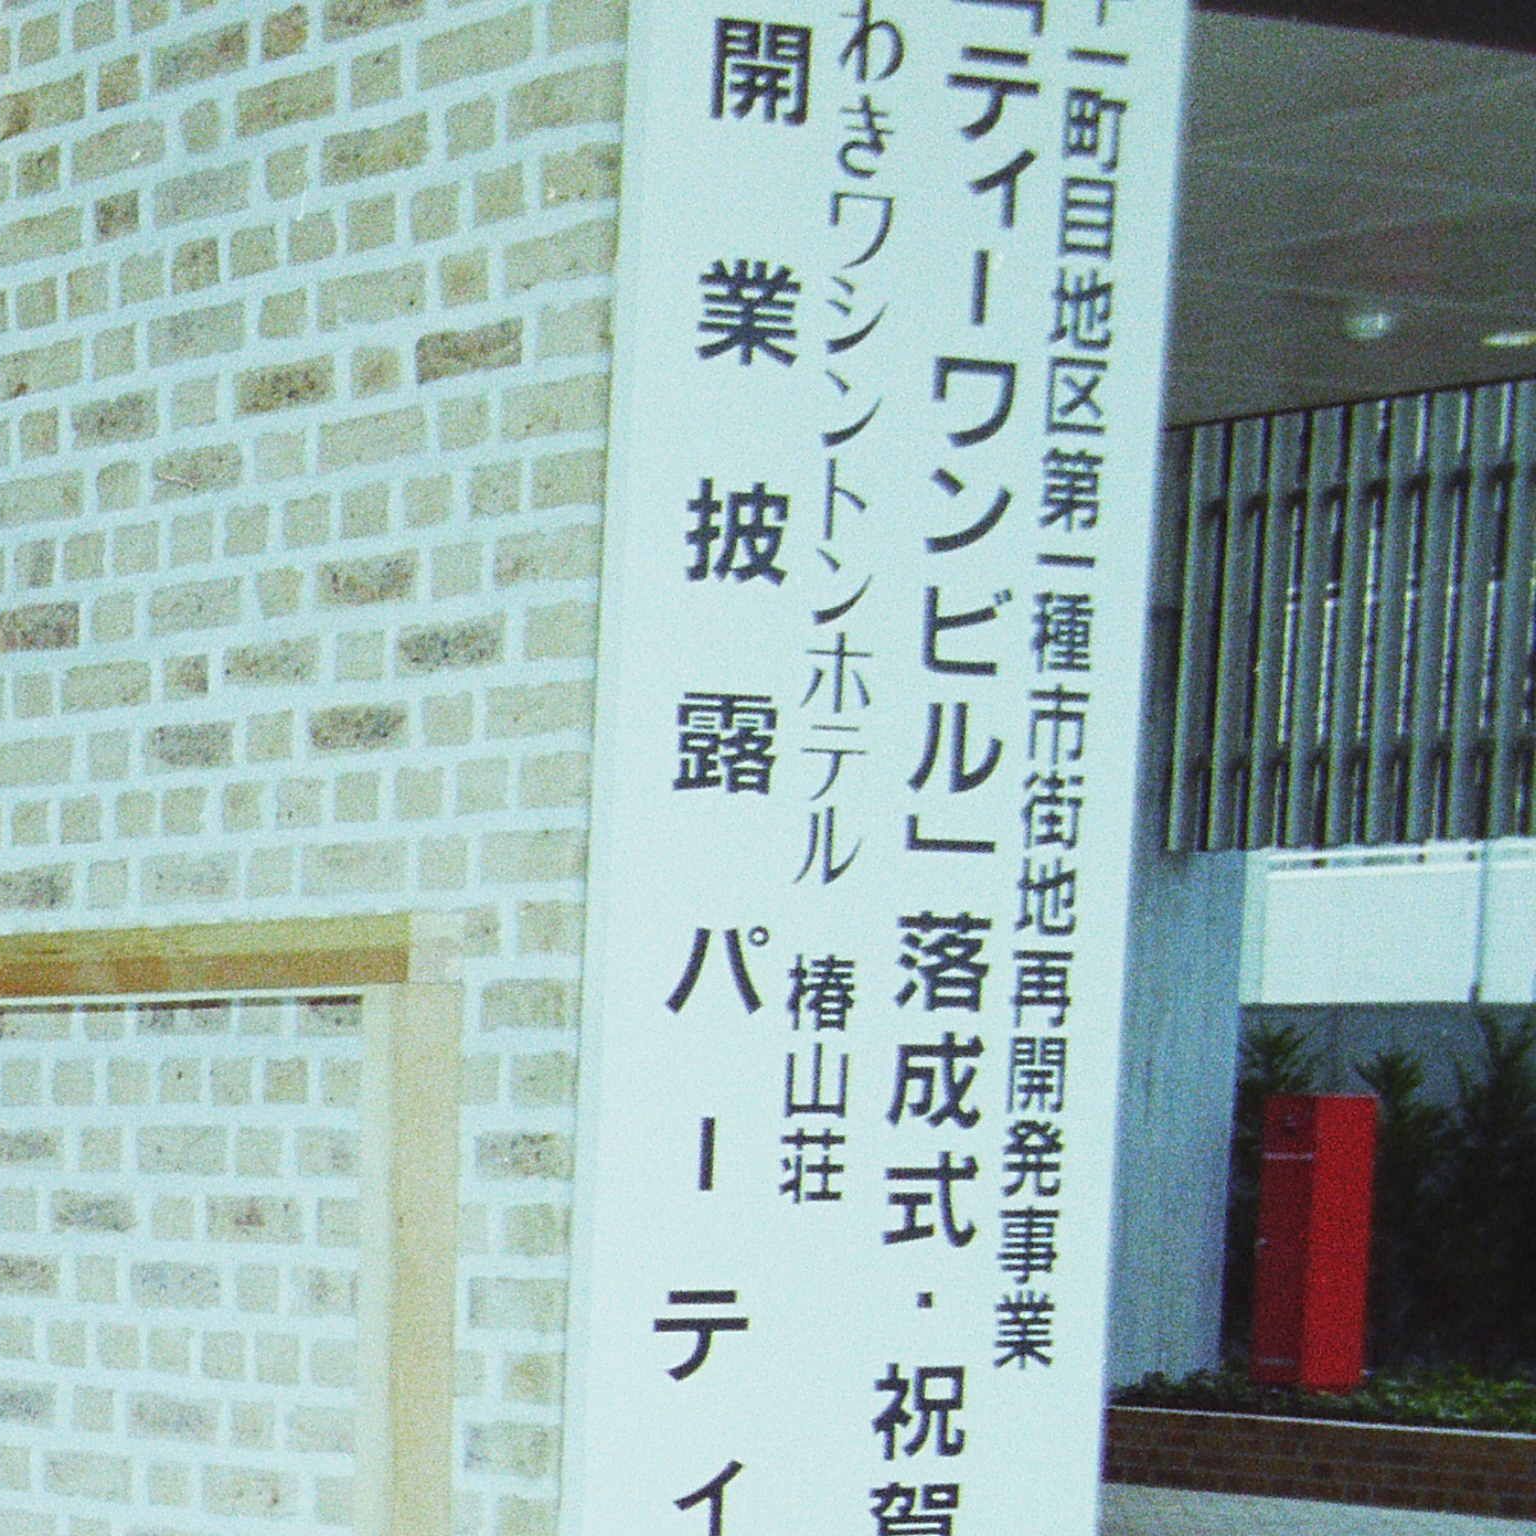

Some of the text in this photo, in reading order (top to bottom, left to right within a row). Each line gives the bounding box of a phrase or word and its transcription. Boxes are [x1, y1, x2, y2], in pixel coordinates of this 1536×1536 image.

[779, 953, 856, 1204] 椿山荘
[993, 0, 1129, 1371] 一町目地区第一種市街地再開発事業
